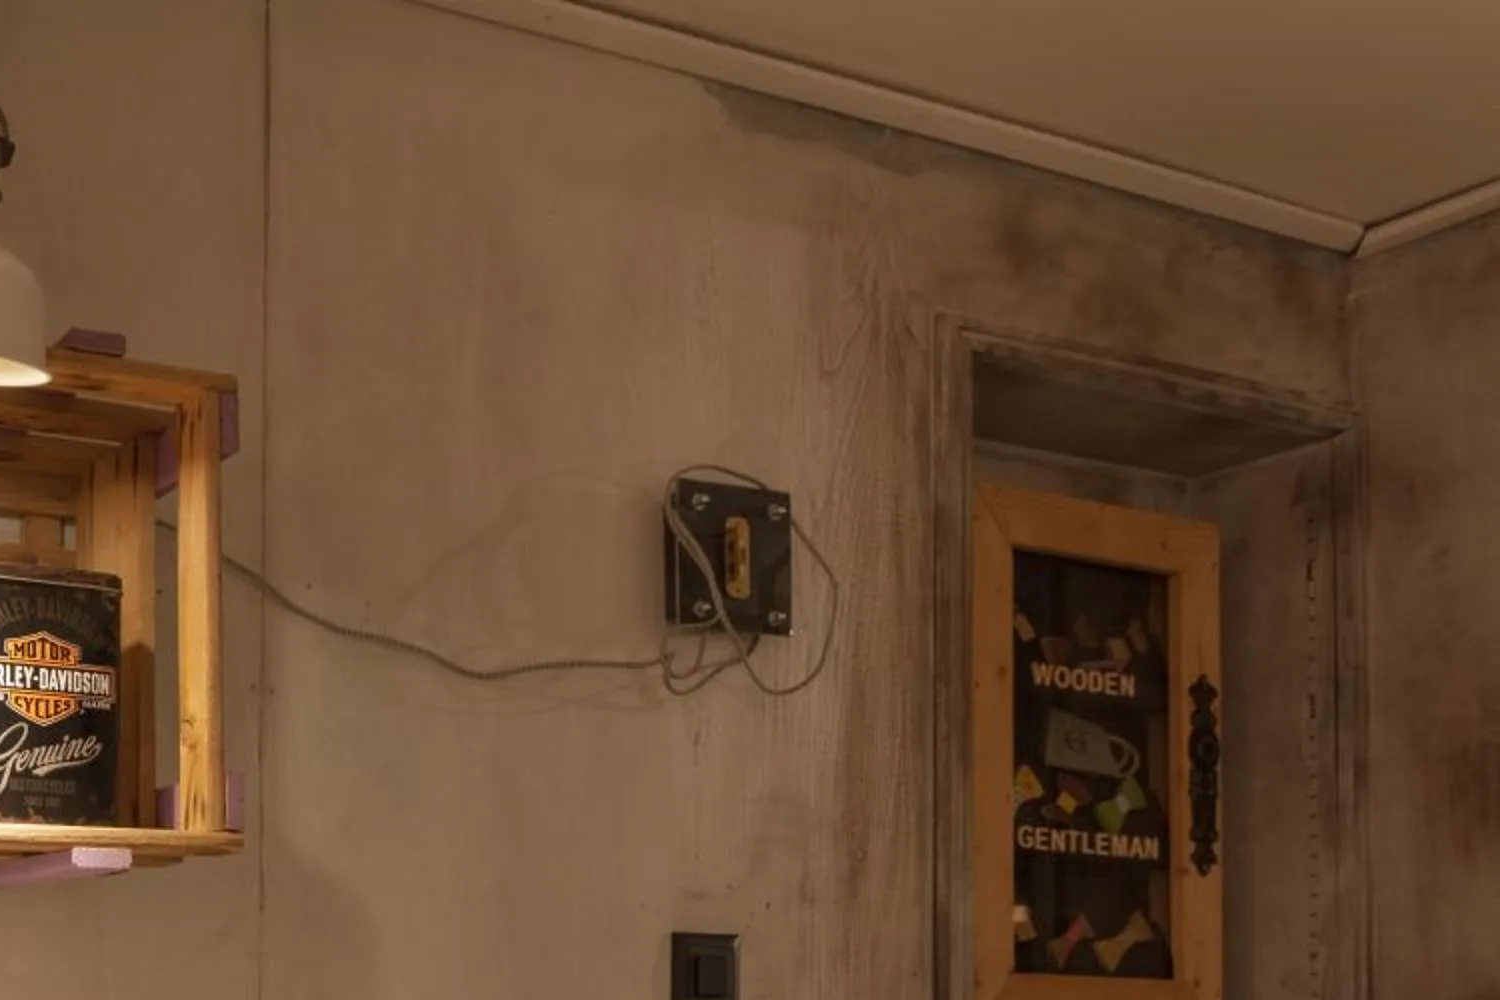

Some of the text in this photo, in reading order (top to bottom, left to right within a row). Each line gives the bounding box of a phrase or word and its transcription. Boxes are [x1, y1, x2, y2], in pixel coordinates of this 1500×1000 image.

[14, 639, 70, 662] MOTOR
[1032, 662, 1135, 697] WOODEN
[15, 696, 70, 719] CYCLES
[1018, 826, 1158, 860] GENTLEMAN
